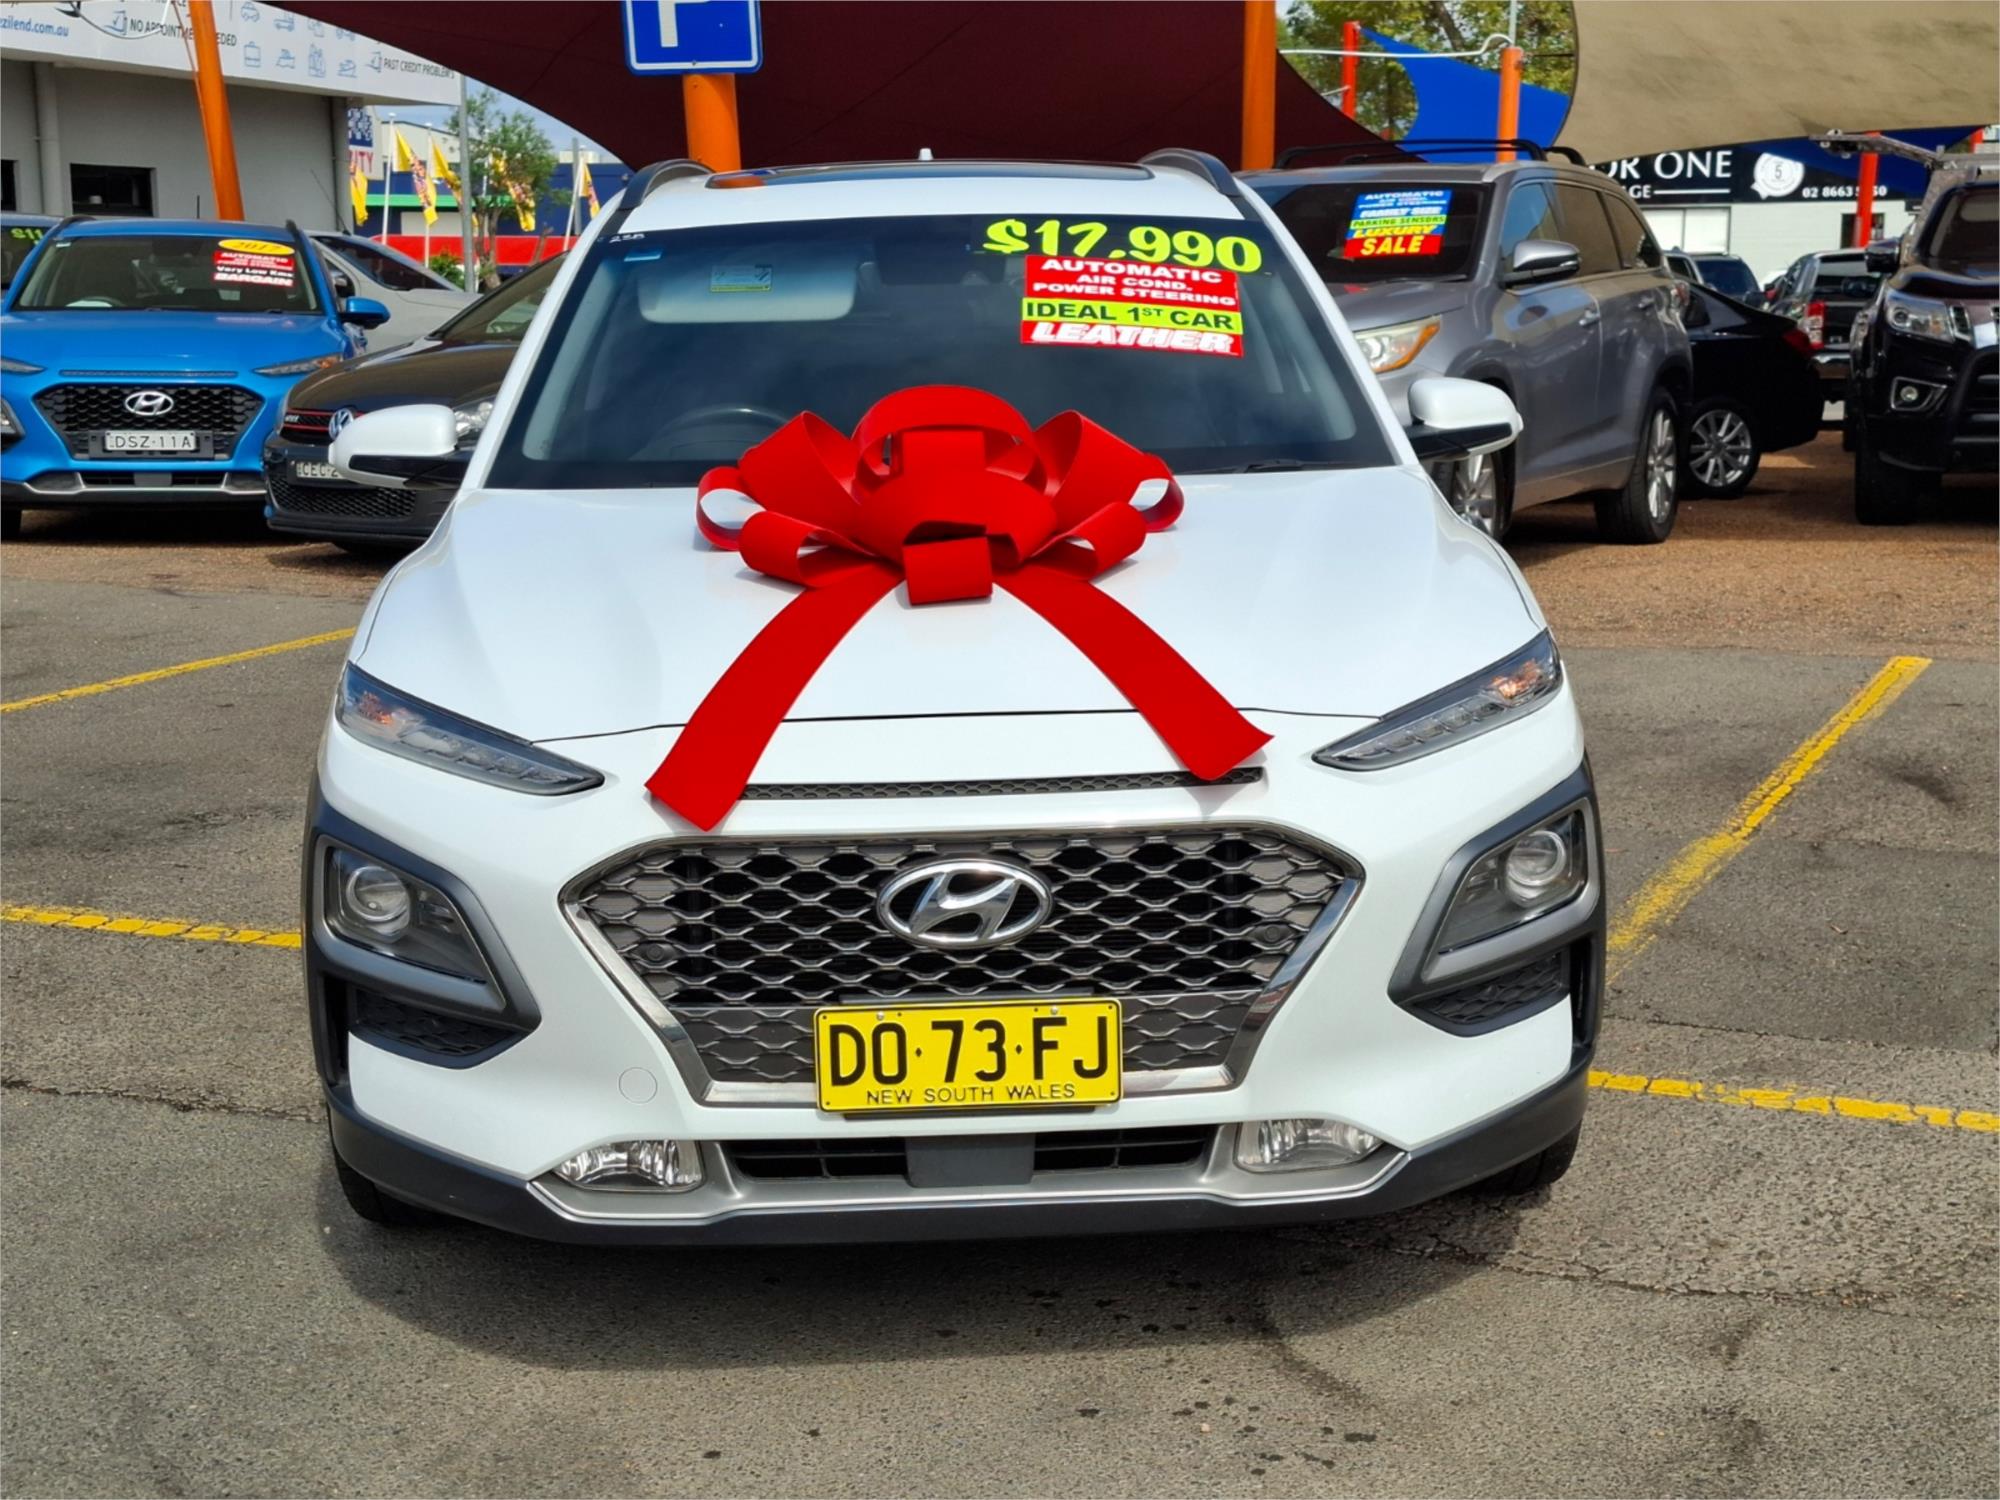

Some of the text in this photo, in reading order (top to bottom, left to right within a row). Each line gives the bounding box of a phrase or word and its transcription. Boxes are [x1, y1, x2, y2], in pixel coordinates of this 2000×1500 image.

[130, 18, 144, 33] NO
[144, 21, 194, 40] APPOINTME
[1653, 150, 1732, 179] ONE
[1802, 187, 1819, 199] 02
[1822, 185, 1853, 198] 8663
[1353, 215, 1445, 228] PARKING SENSORS
[983, 219, 1262, 273] $17,990
[1360, 235, 1425, 256] SALE
[1040, 258, 1222, 284] AUTOMATIC
[1033, 282, 1236, 306] POWER STEERING
[1076, 274, 1194, 292] AIR COND.
[1027, 302, 1117, 321] IDEAL
[1170, 310, 1234, 330] CAR
[1030, 321, 1234, 353] LEATHER
[866, 1083, 1075, 1105] NEW SOUTH WALES
